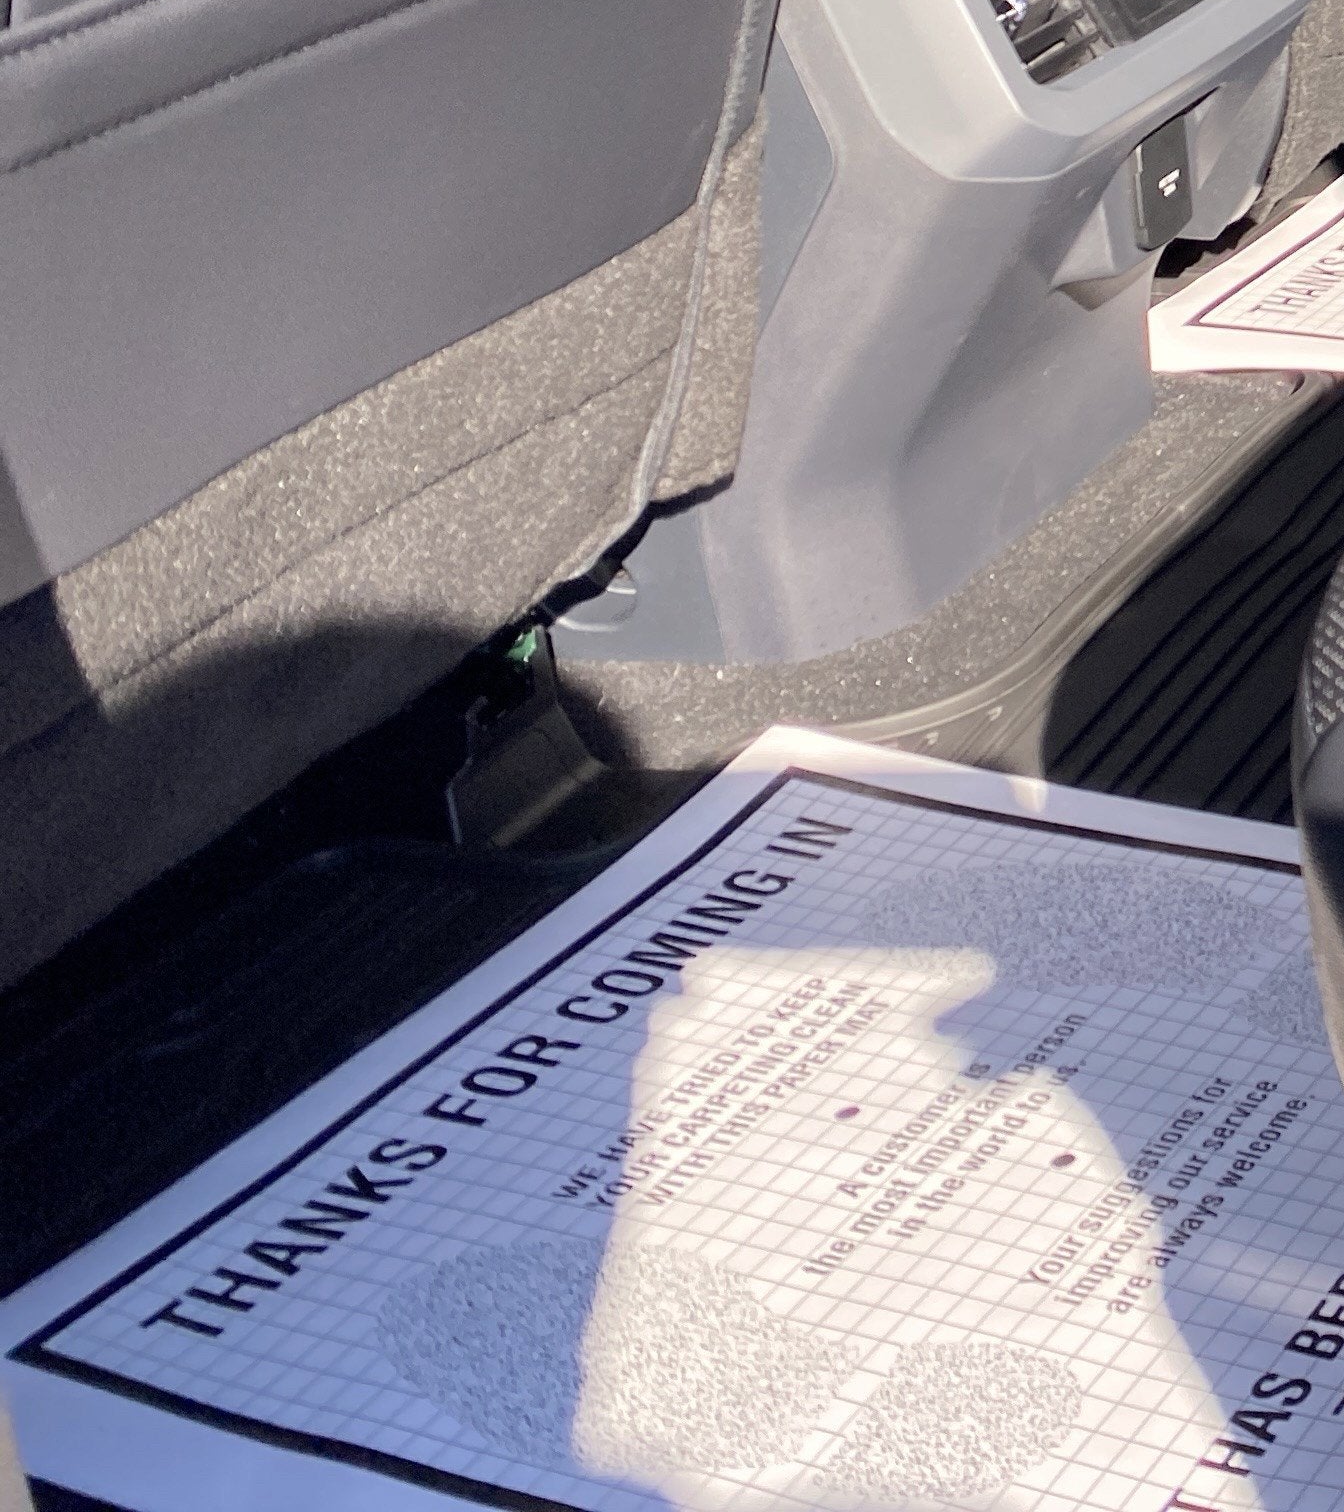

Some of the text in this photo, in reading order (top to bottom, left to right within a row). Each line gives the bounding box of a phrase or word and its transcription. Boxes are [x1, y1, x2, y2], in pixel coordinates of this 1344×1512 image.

[141, 818, 853, 1337] THANKS FOR COMING IN
[552, 977, 826, 1200] WE HAVE TRIED TO KEEP
[595, 982, 869, 1207] YOUR CARPETING CLEAN
[644, 1000, 889, 1206] WITH THIS PAPER MAT
[802, 1012, 1088, 1276] the most important person
[837, 1062, 991, 1198] A customer is
[887, 1216, 927, 1239] in
[915, 1176, 966, 1212] the
[958, 1113, 1028, 1172] world
[1015, 1092, 1051, 1111] to
[1019, 1077, 1233, 1285] Your suggestions for
[1055, 1080, 1278, 1306] improving our service
[1107, 1094, 1316, 1314] are always welcome.
[1198, 1372, 1312, 1477] HAS
